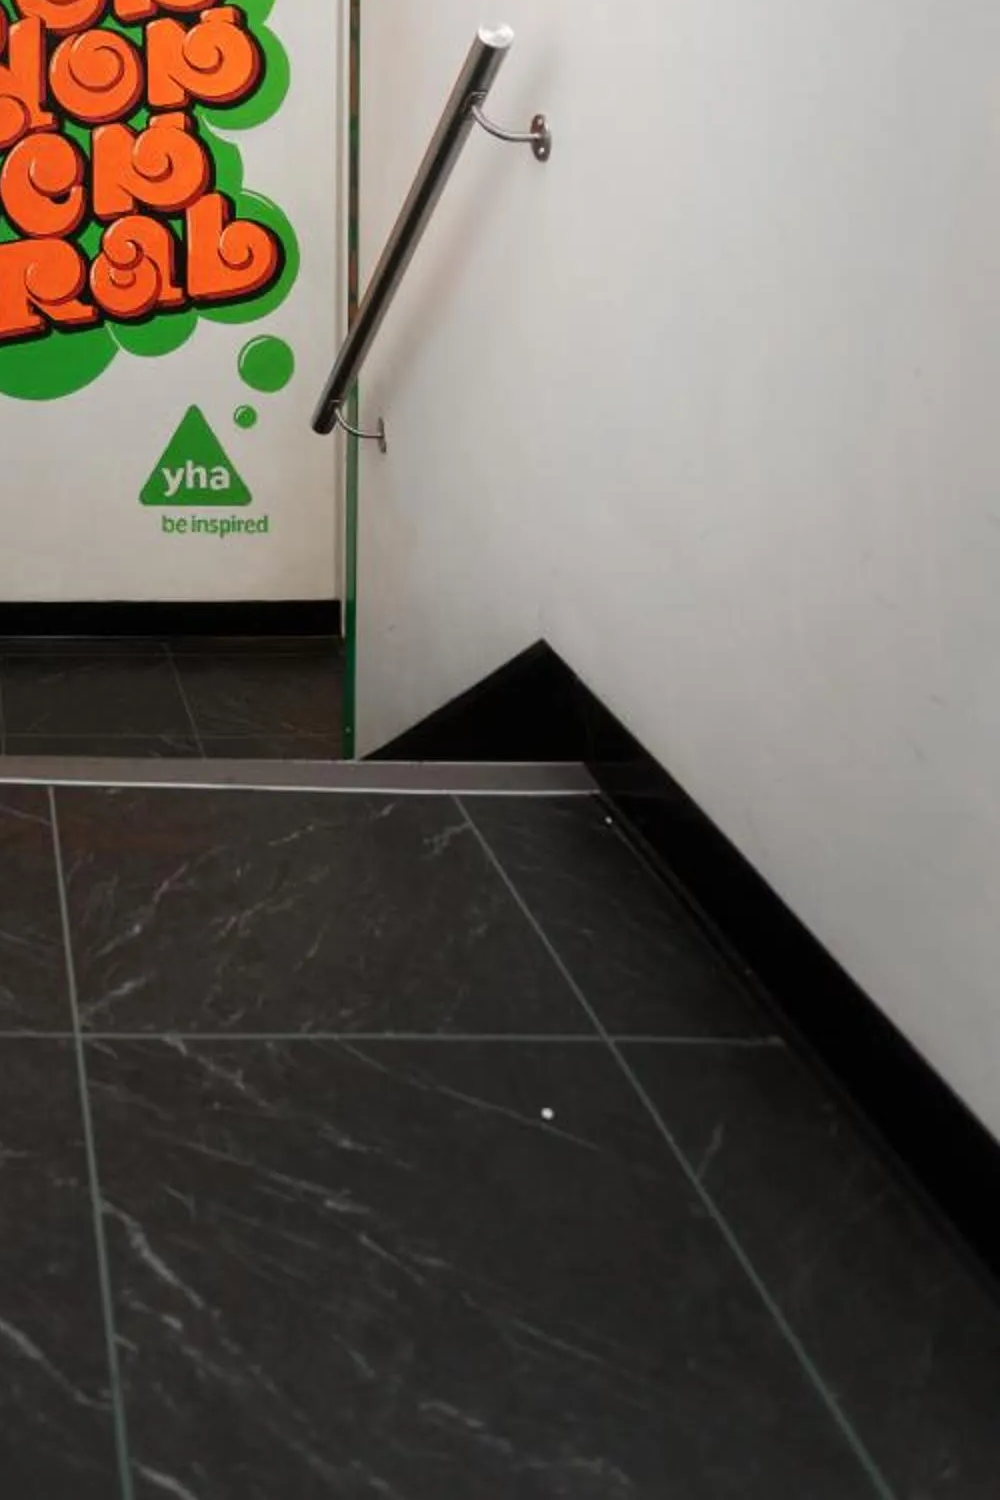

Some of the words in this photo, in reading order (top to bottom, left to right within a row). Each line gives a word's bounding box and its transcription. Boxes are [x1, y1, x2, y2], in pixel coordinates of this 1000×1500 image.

[161, 460, 231, 497] yha
[162, 515, 187, 533] be
[191, 514, 269, 540] inspired
